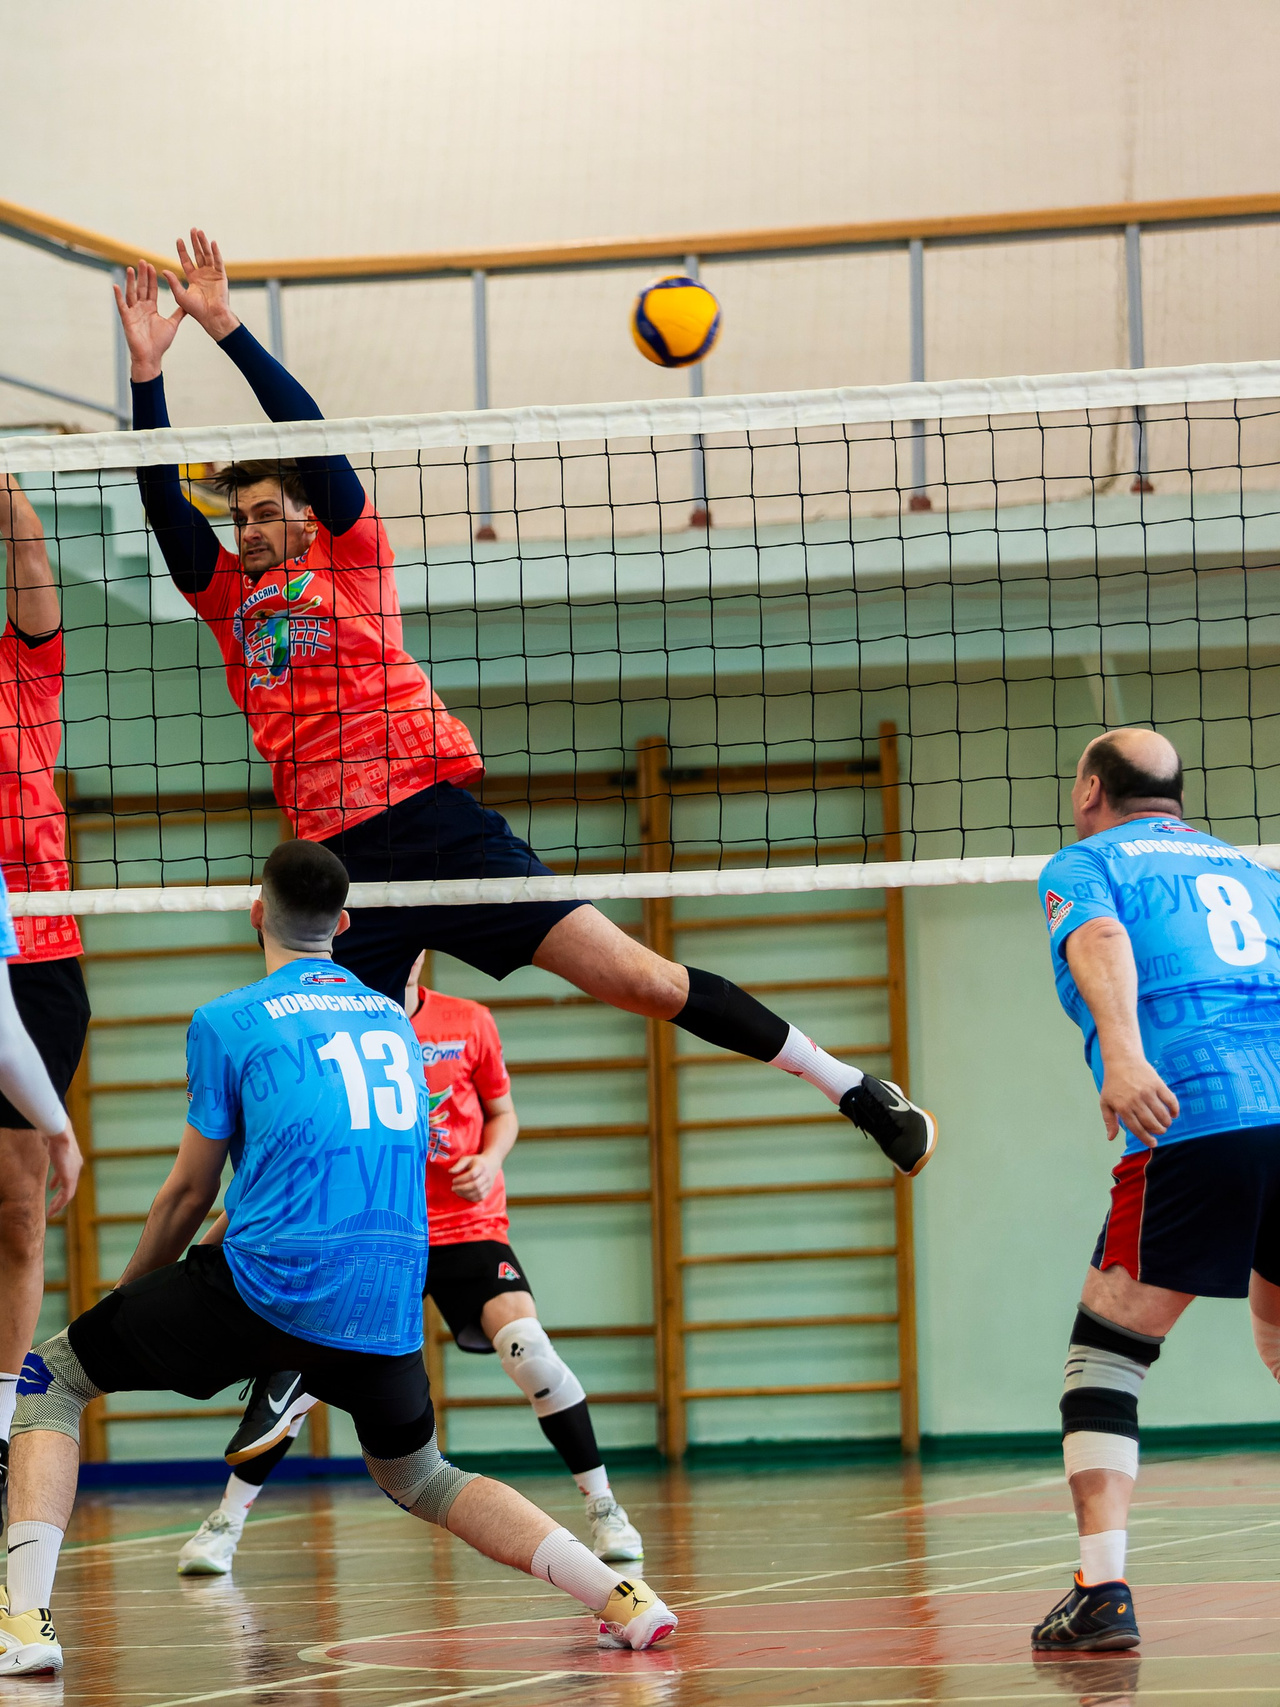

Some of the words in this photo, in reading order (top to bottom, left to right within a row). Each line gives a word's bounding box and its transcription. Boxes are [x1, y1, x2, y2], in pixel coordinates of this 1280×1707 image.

[1119, 839, 1269, 872] НОВОСИБИР
[1116, 874, 1199, 925] СГУП
[1195, 873, 1268, 967] 8
[247, 1032, 340, 1103] СГУП
[317, 1030, 418, 1131] 13
[283, 1144, 427, 1226] СГУП
